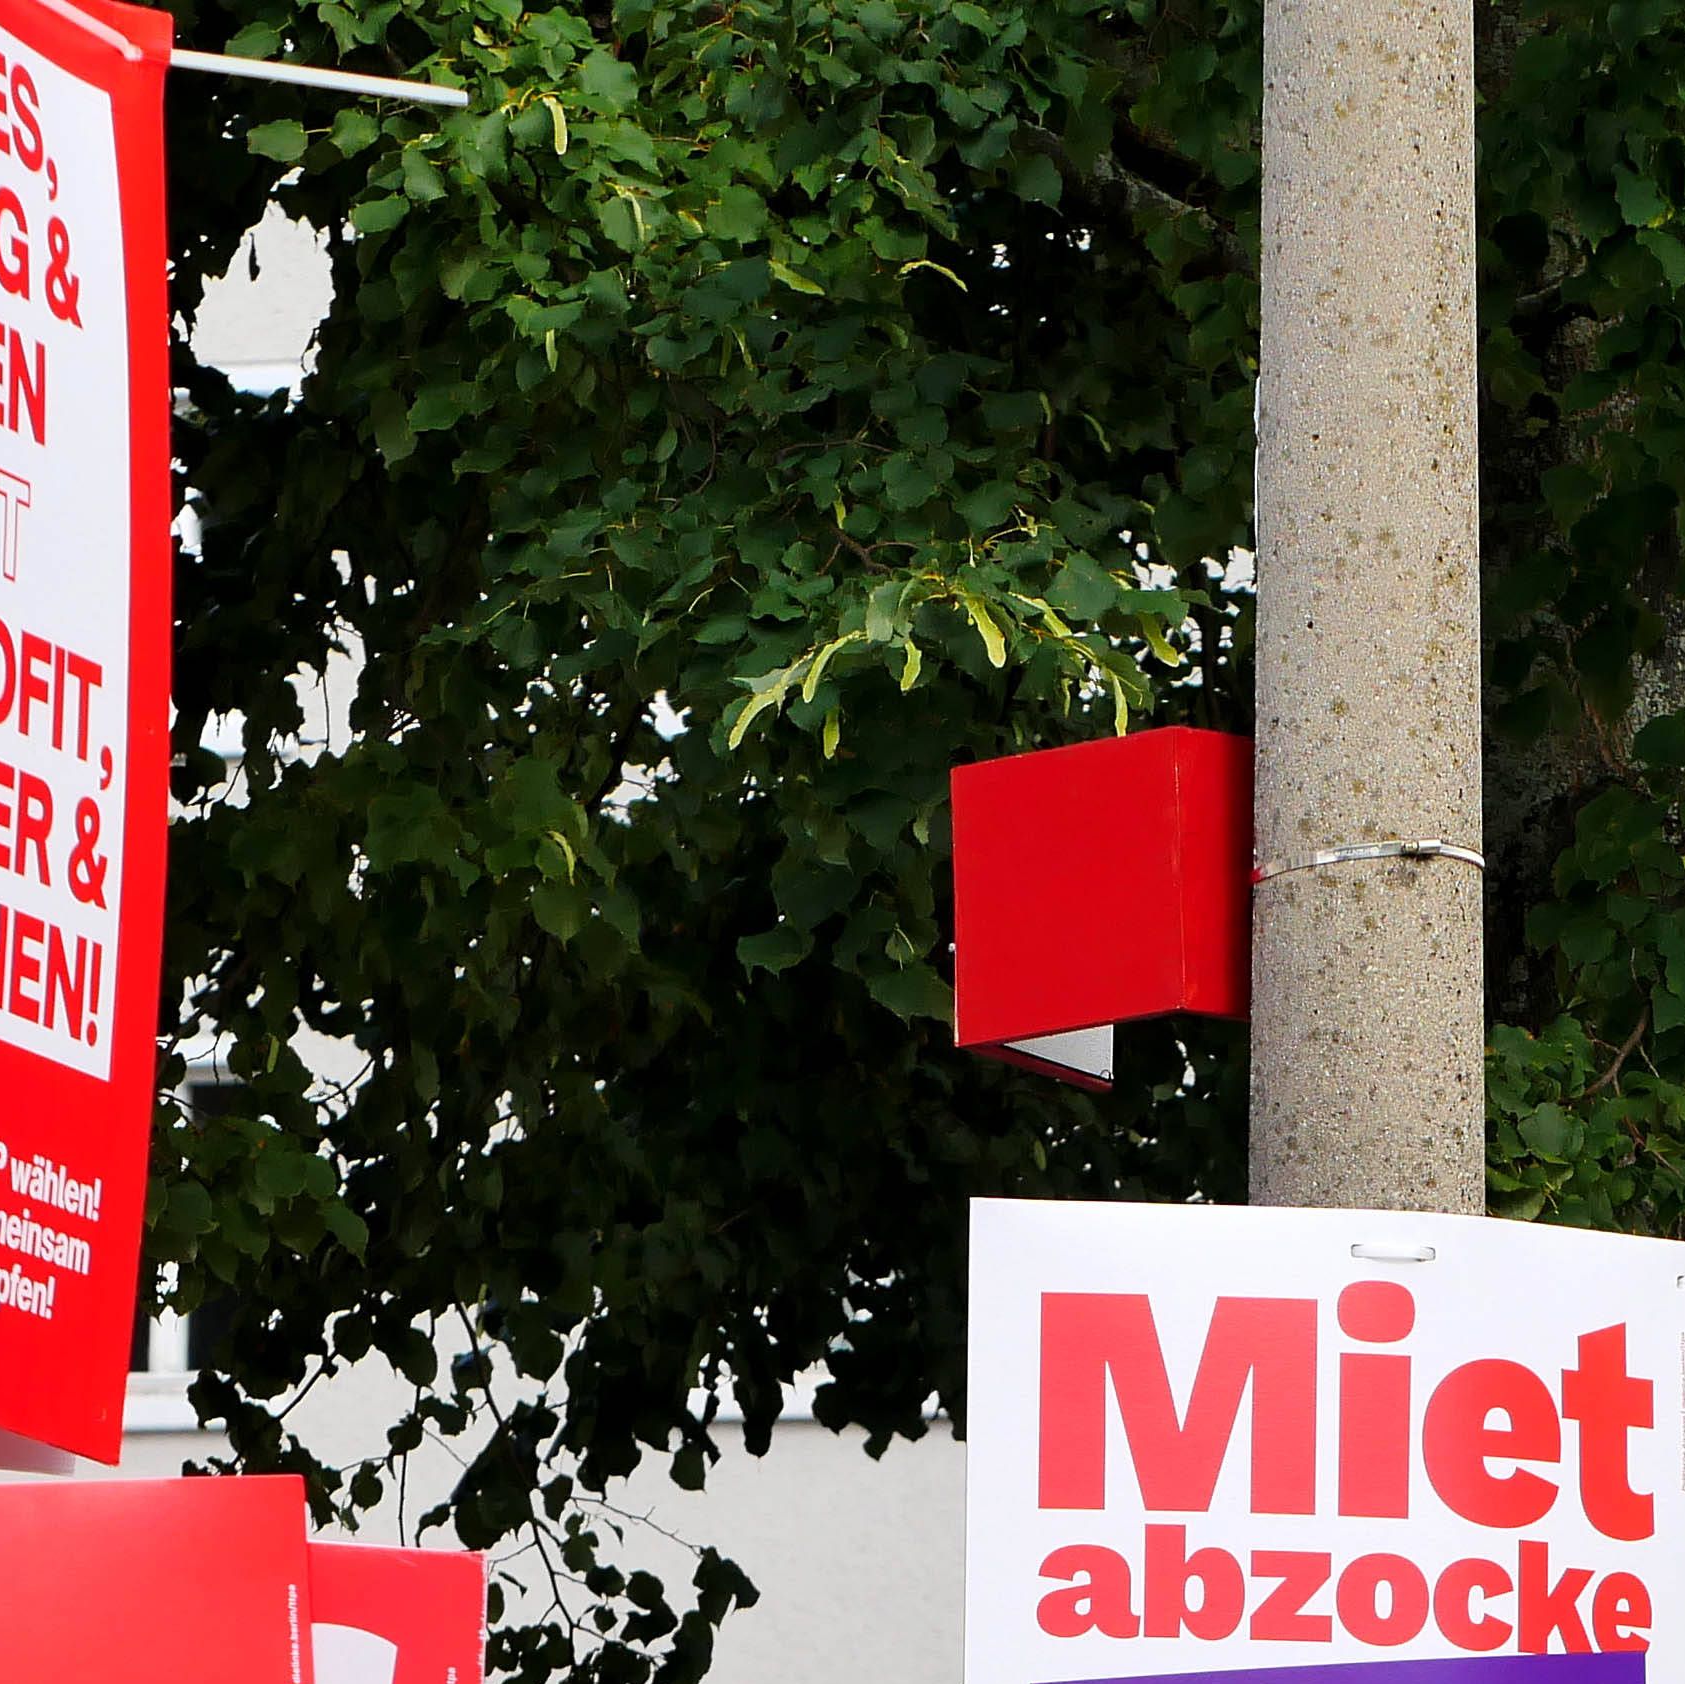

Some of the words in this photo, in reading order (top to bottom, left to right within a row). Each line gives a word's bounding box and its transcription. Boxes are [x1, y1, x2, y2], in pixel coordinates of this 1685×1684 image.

[45, 216, 83, 329] &
[68, 796, 108, 910] &
[11, 1156, 102, 1222] wählen!
[1038, 1280, 1655, 1542] Miet
[1036, 1522, 1653, 1655] abzocke
